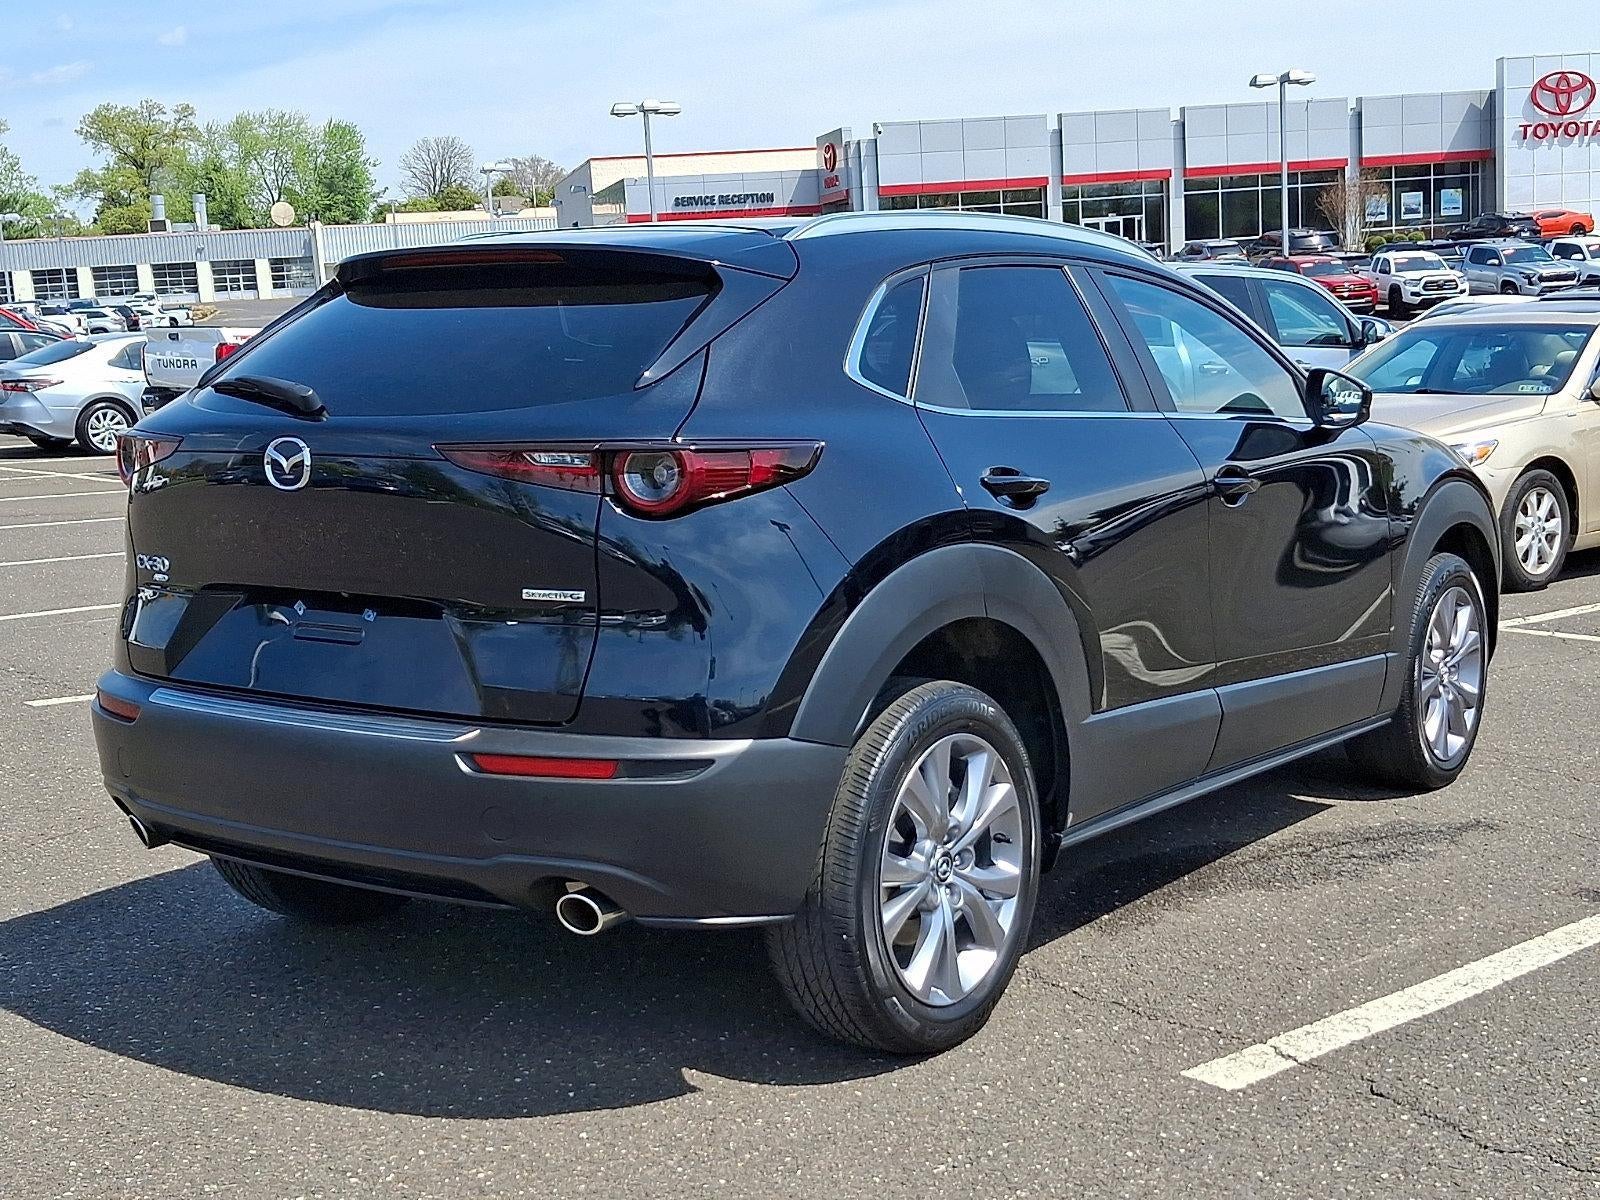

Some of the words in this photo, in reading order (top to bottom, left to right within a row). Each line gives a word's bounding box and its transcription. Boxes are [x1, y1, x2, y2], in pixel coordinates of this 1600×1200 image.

[1518, 120, 1600, 140] TOYOTA
[674, 195, 716, 207] SERVICE
[718, 192, 775, 205] RECEPTION
[156, 358, 198, 369] TUNDRA
[137, 553, 170, 572] CX-30
